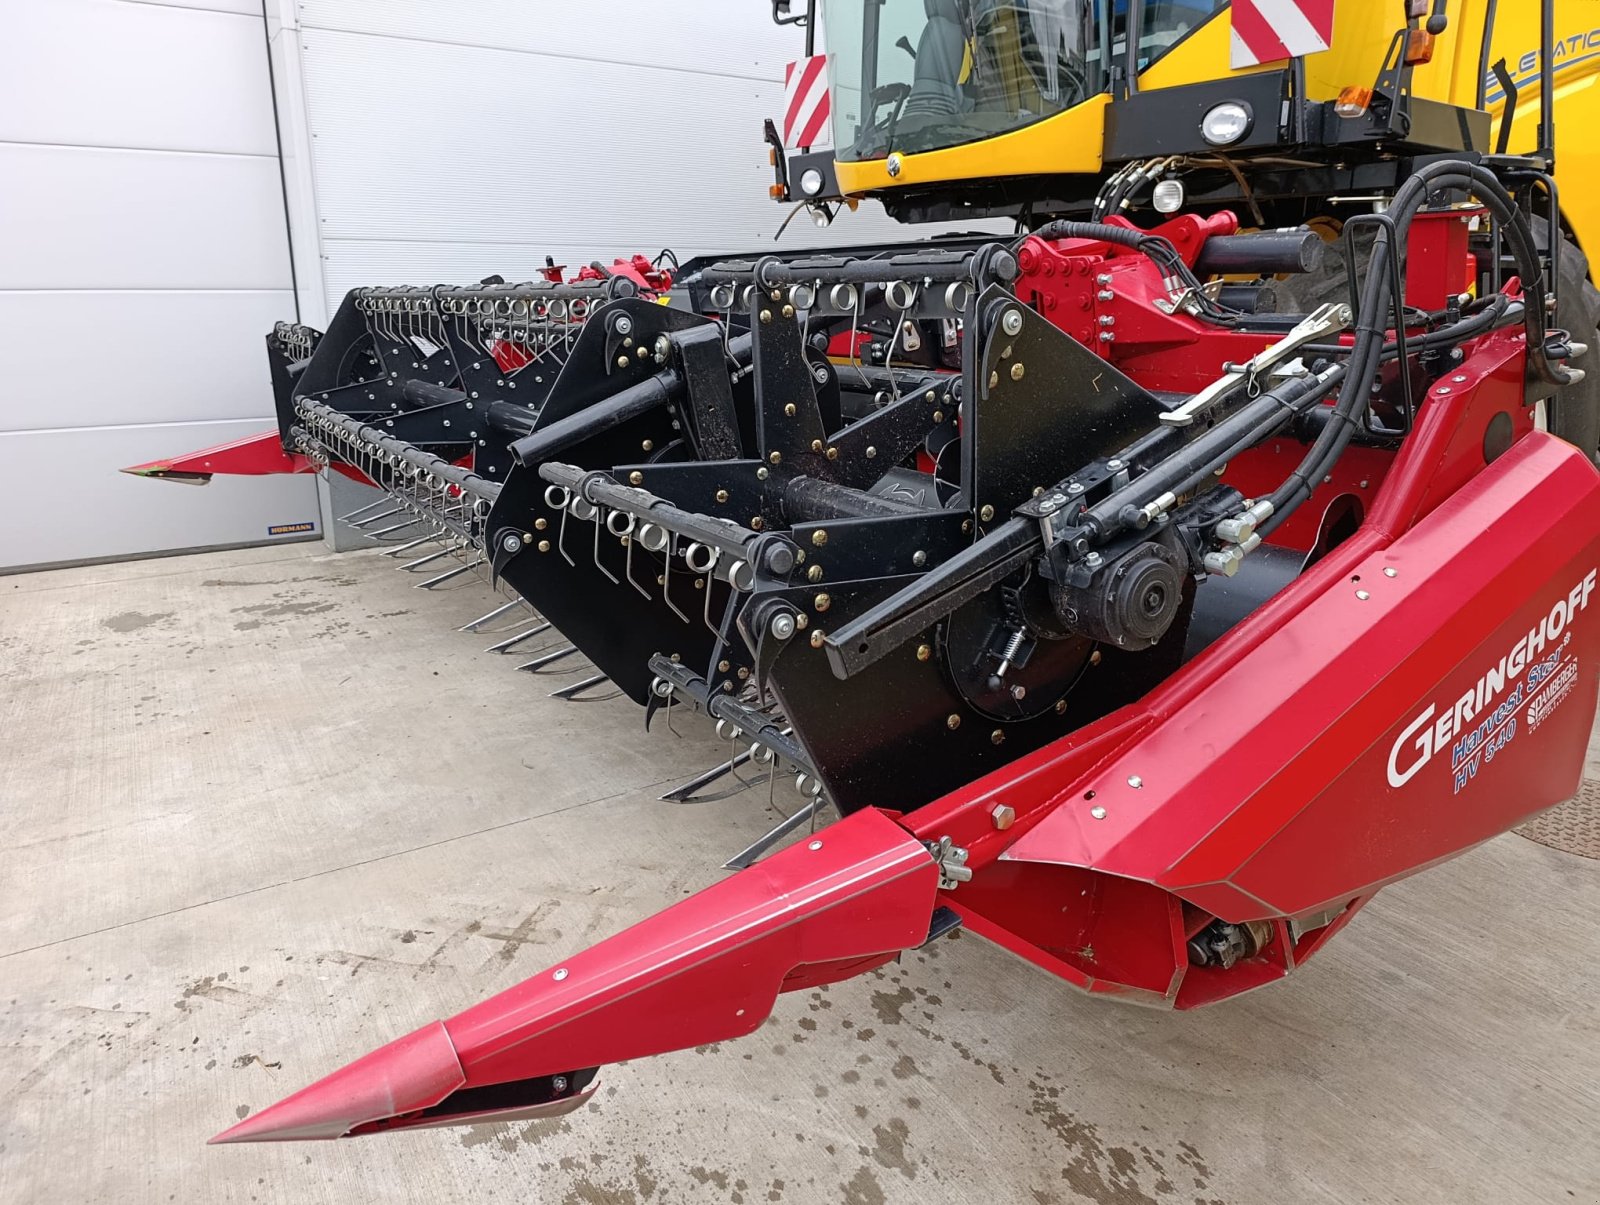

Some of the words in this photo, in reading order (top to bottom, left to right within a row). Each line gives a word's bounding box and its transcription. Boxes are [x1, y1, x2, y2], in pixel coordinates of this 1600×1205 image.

[1387, 567, 1597, 788] GERINGHOFF
[1452, 682, 1523, 769] Harvest
[1454, 750, 1482, 795] HV
[1485, 717, 1516, 763] 540
